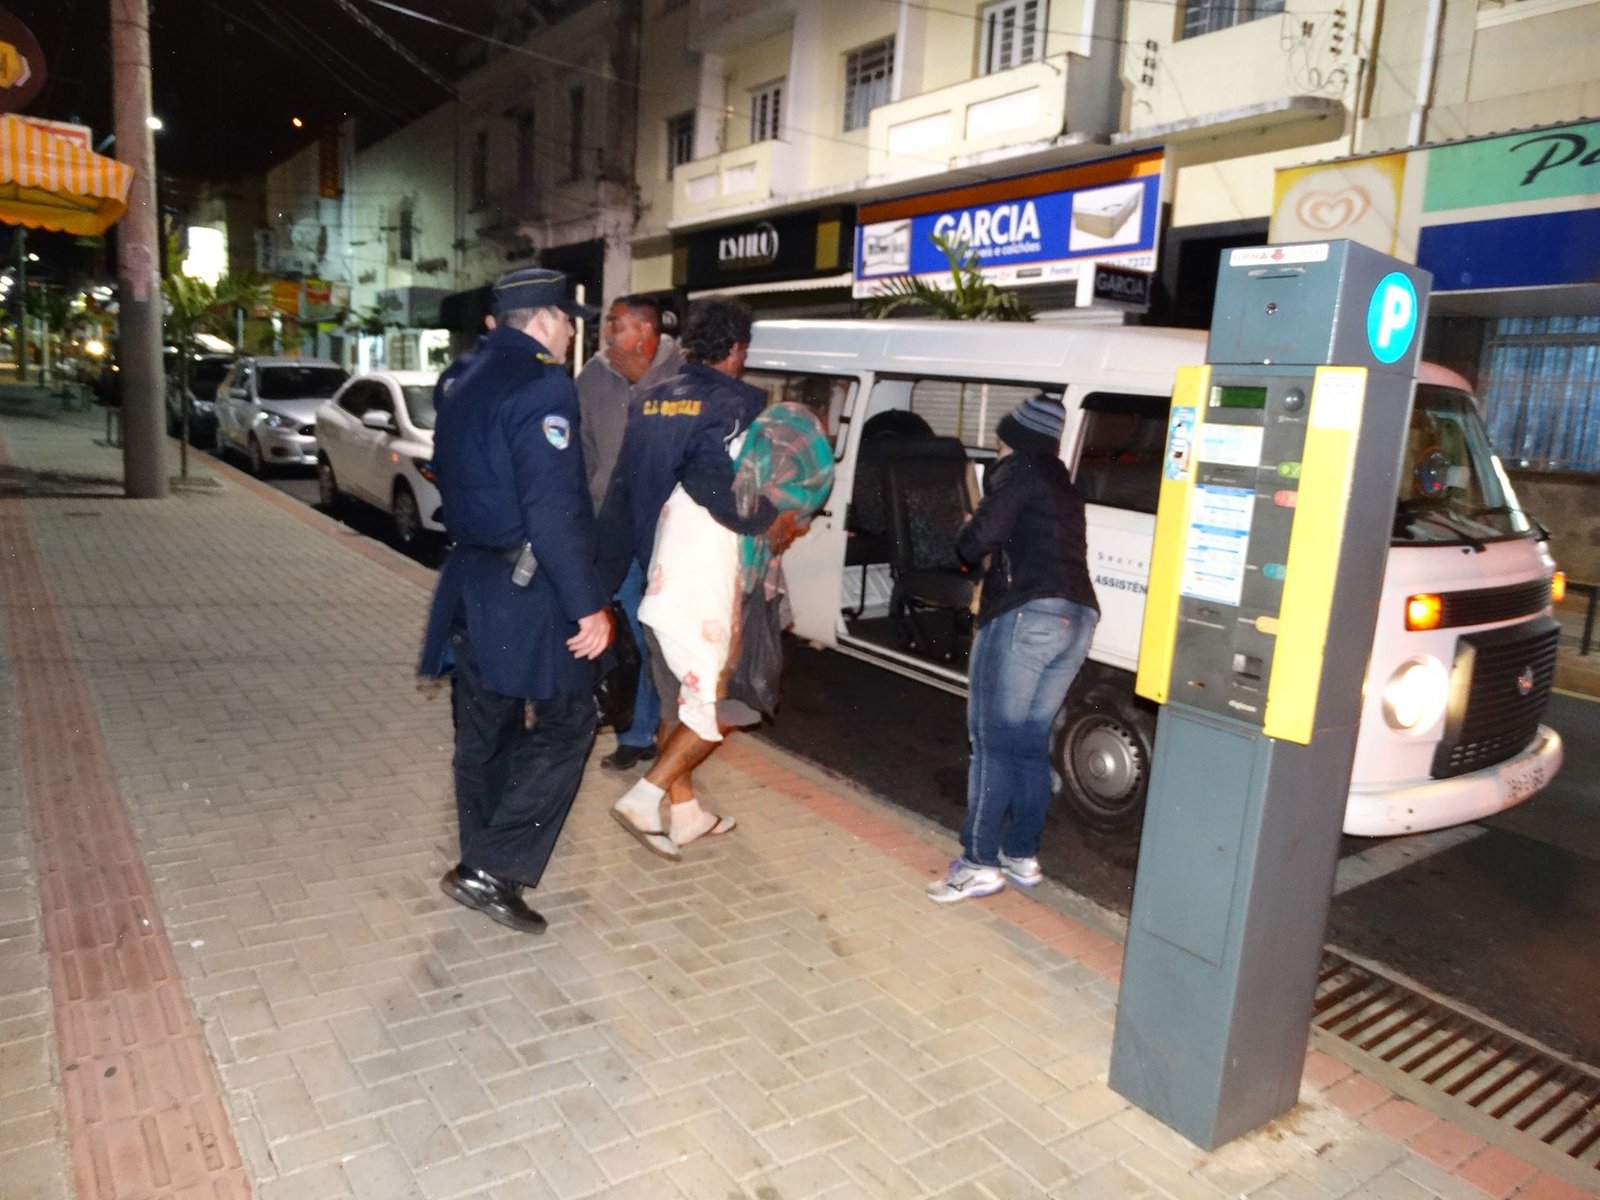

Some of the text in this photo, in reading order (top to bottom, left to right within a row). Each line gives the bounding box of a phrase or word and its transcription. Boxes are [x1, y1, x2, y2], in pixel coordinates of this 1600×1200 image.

[933, 200, 1040, 252] GARCIA
[1097, 273, 1144, 296] GARCIA
[1377, 284, 1413, 348] P
